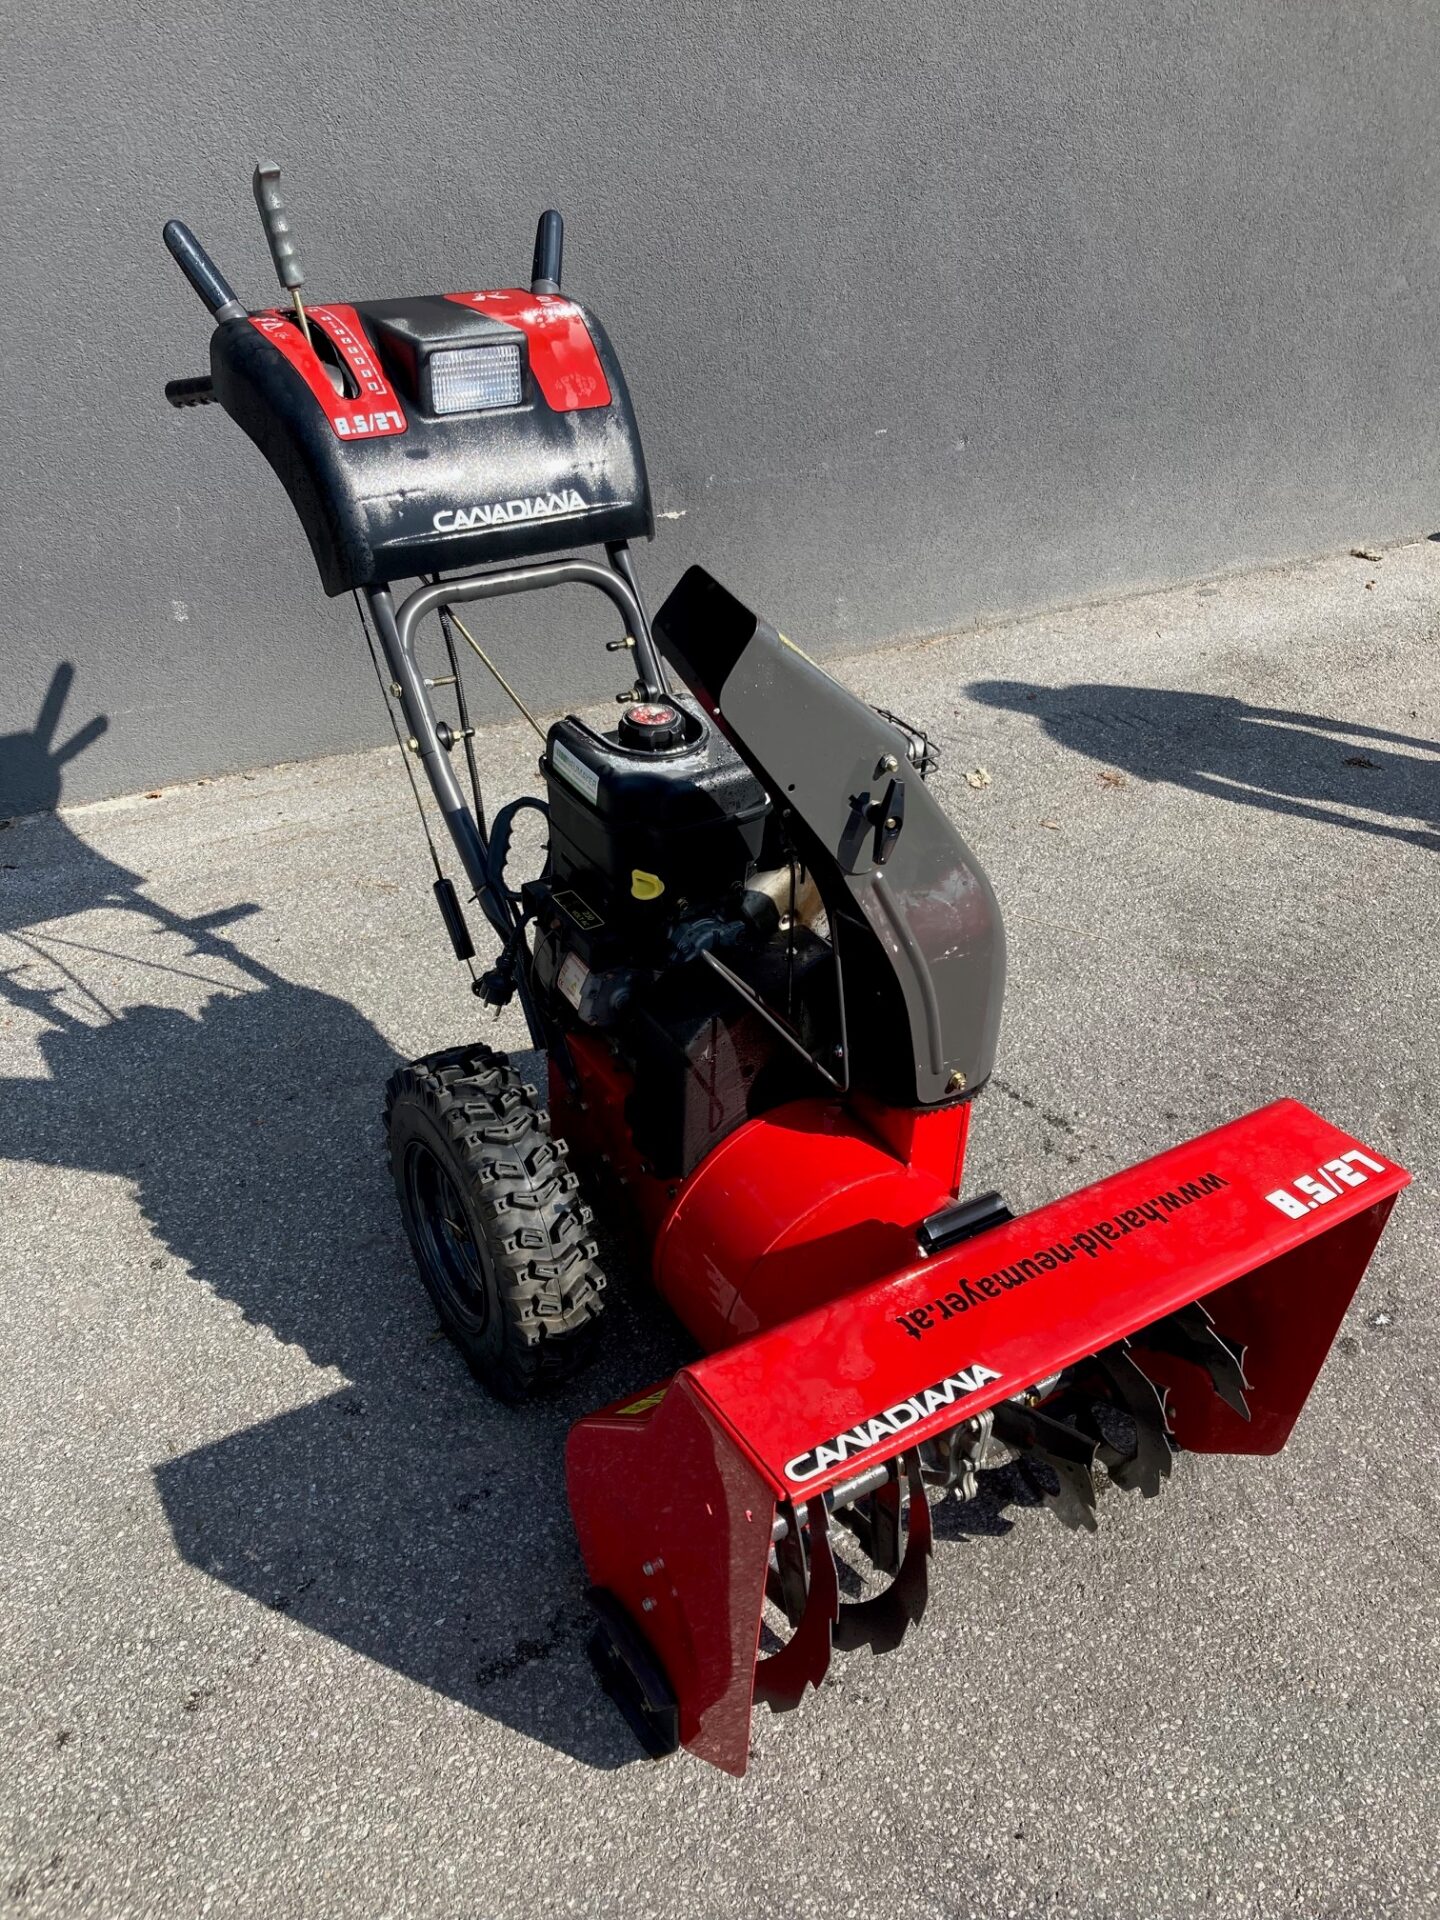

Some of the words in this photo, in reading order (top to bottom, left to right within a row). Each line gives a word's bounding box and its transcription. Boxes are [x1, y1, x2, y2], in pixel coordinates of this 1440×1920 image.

[334, 410, 403, 436] 8.5/27
[432, 488, 589, 533] CANADIANA
[1264, 1149, 1387, 1220] 8.5/27
[895, 1172, 1231, 1341] www.harald-neumayer.at
[784, 1364, 1004, 1482] CANADIANA
